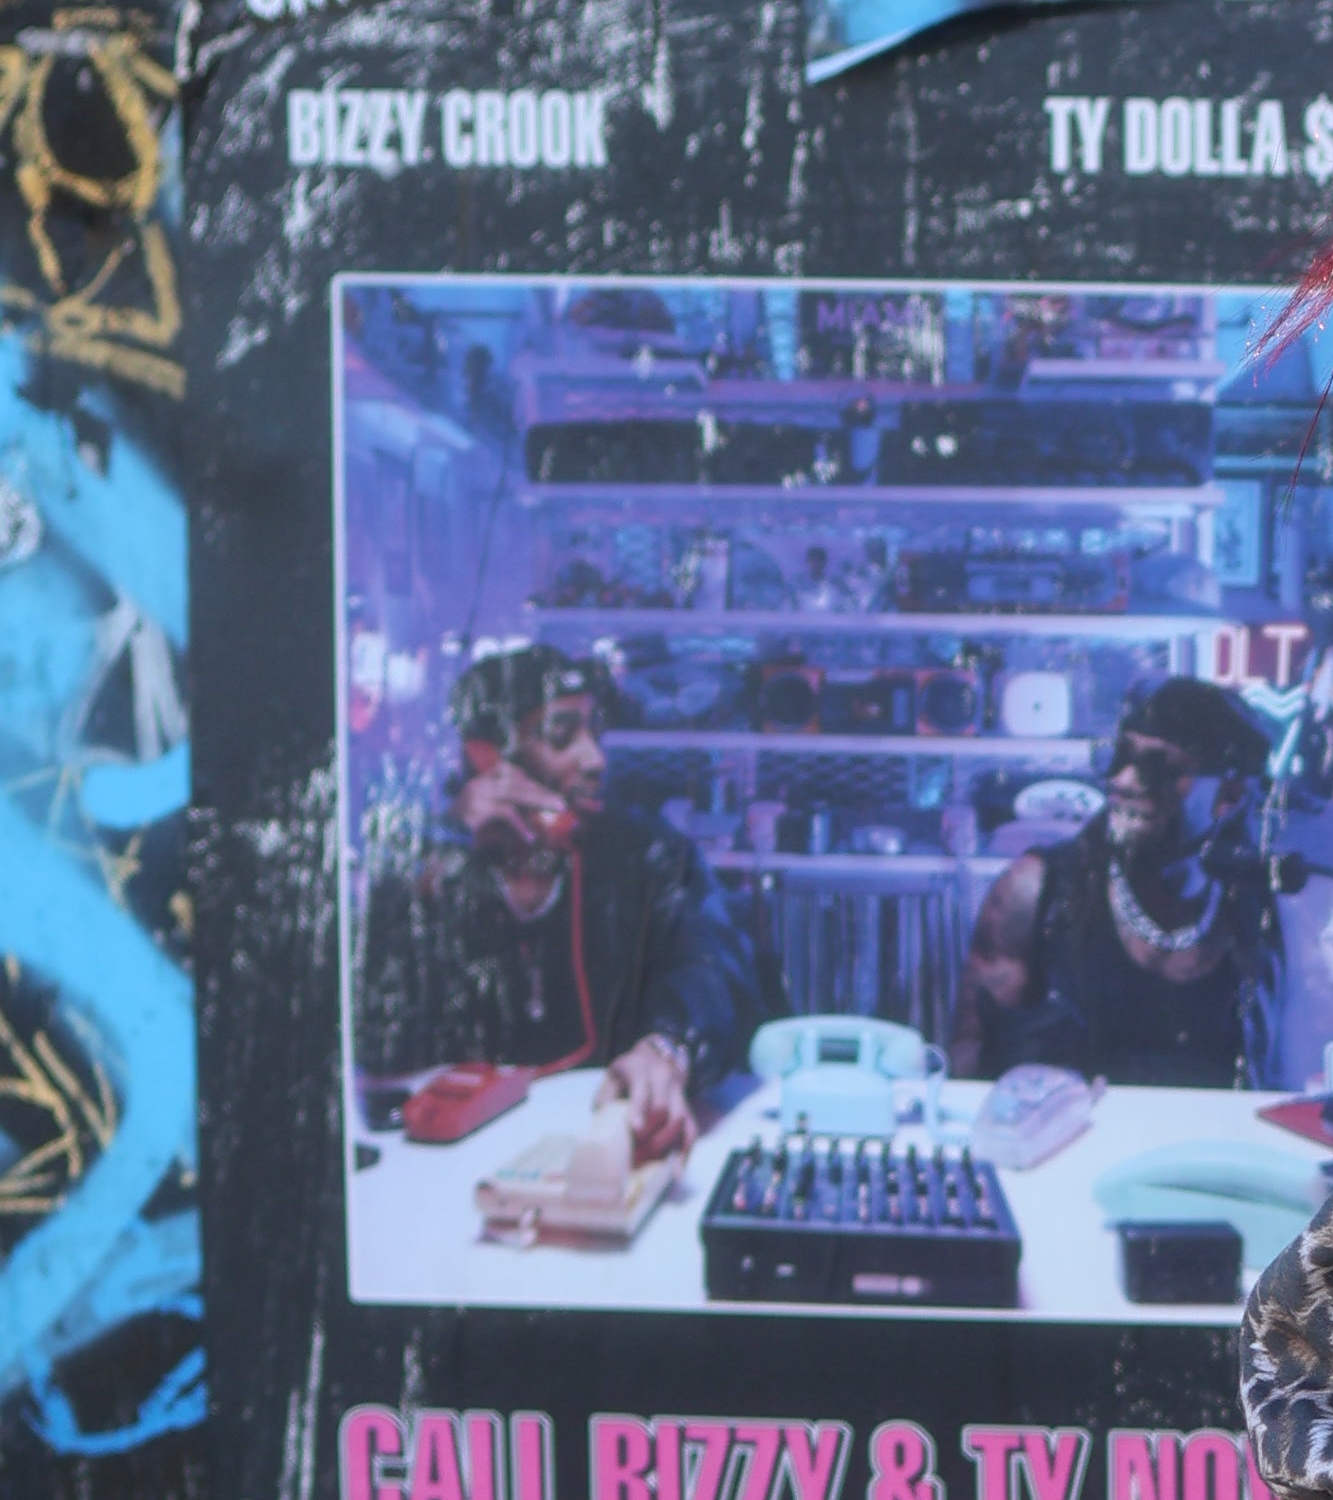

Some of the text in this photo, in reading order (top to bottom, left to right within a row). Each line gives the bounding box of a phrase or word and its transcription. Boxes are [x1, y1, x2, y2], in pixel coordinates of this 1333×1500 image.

[286, 87, 608, 168] BIZZY CROOK
[1042, 95, 1110, 175] TY
[1122, 96, 1290, 177] DOLLA
